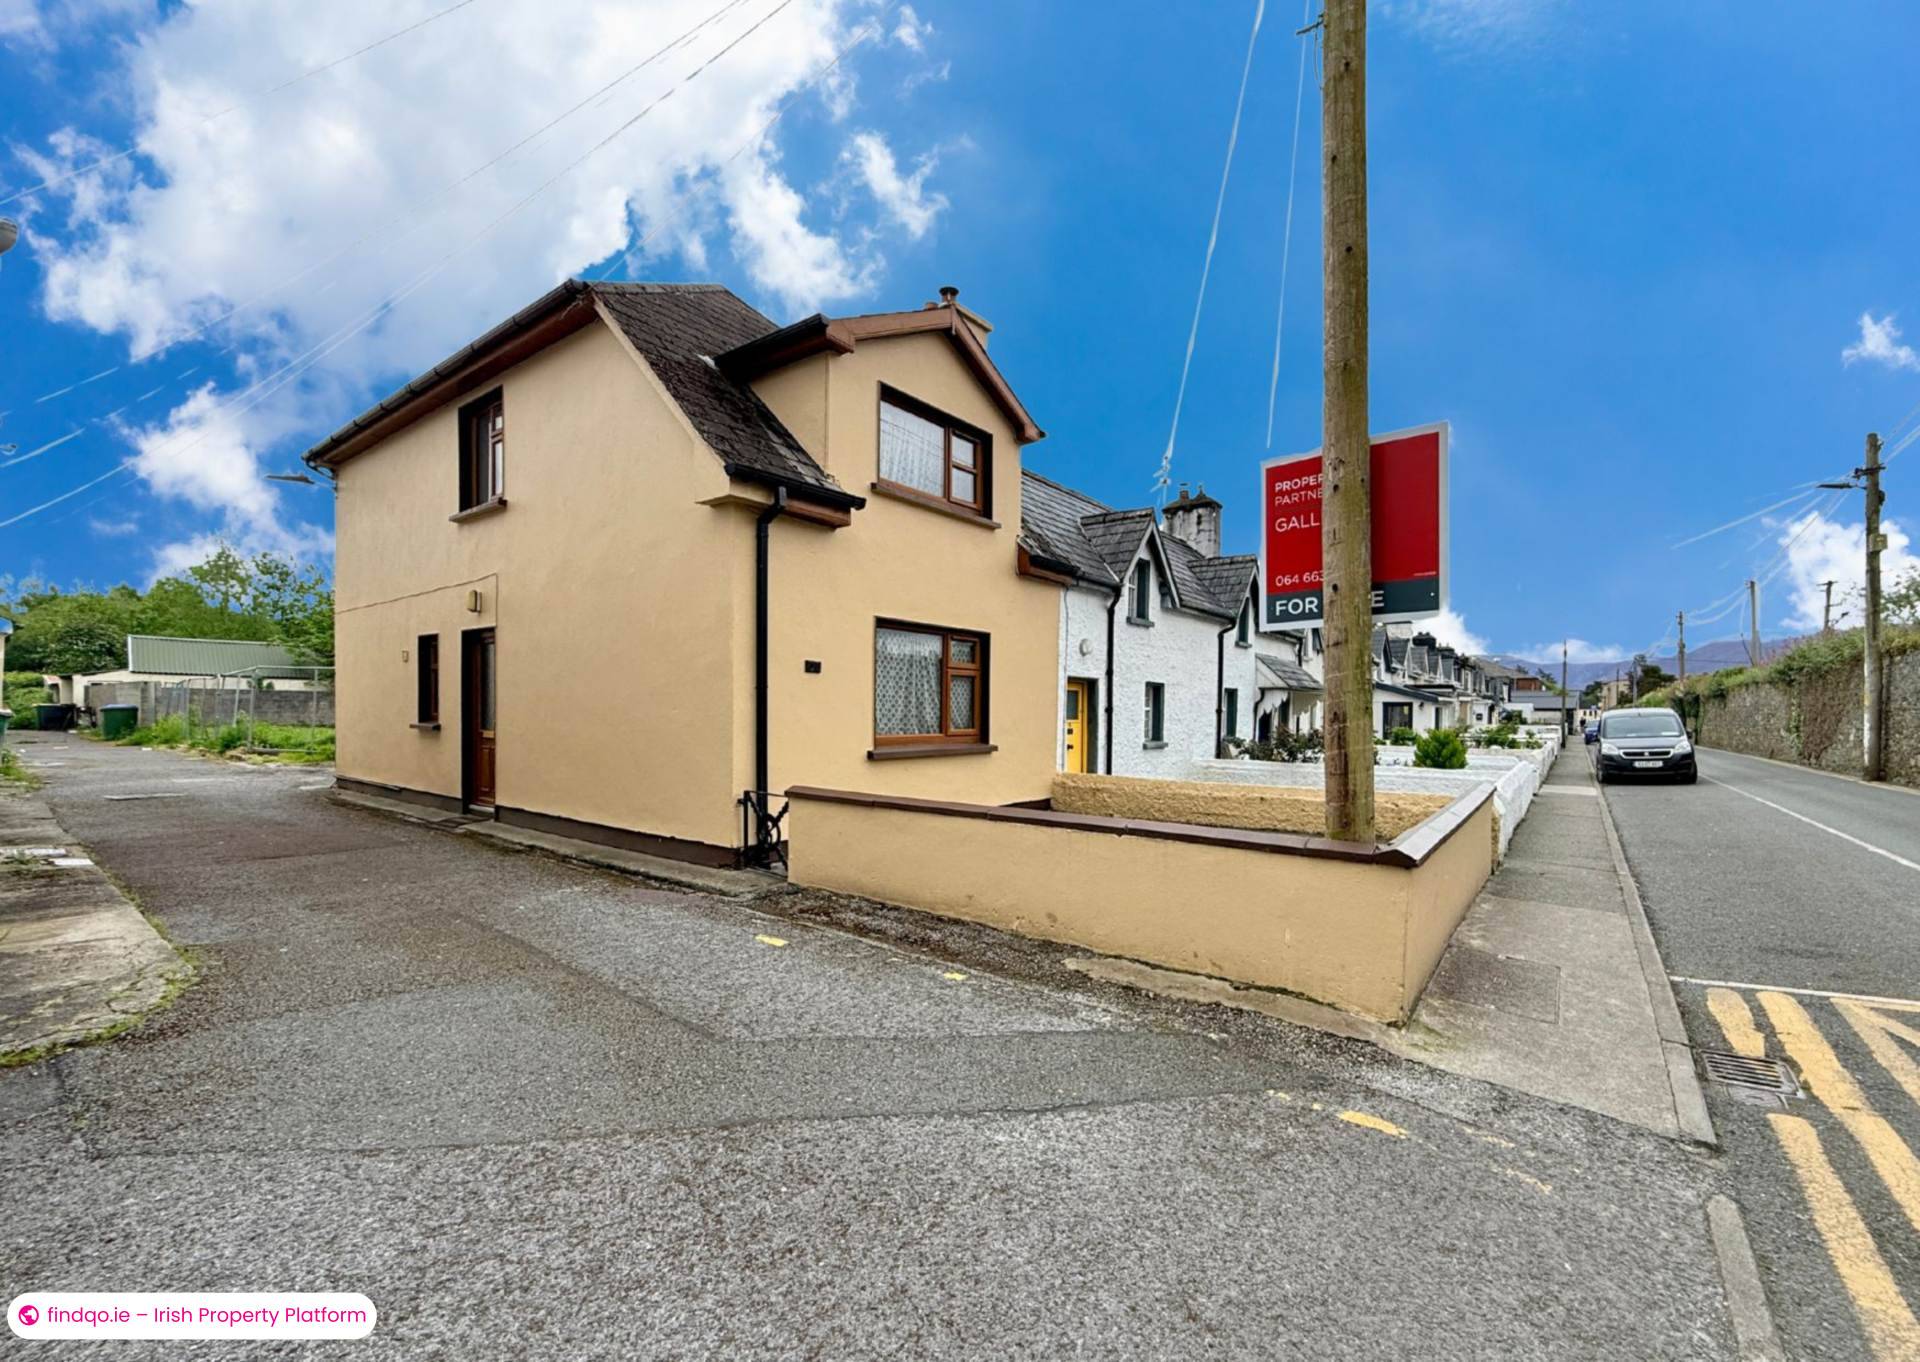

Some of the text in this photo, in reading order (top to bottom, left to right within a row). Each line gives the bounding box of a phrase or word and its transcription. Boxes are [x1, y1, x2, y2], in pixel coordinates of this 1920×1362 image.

[1275, 474, 1324, 492] PROPER
[1275, 488, 1323, 506] PARTNE
[1275, 513, 1320, 532] GALL
[1275, 575, 1299, 586] 064
[1276, 597, 1318, 615] FOR
